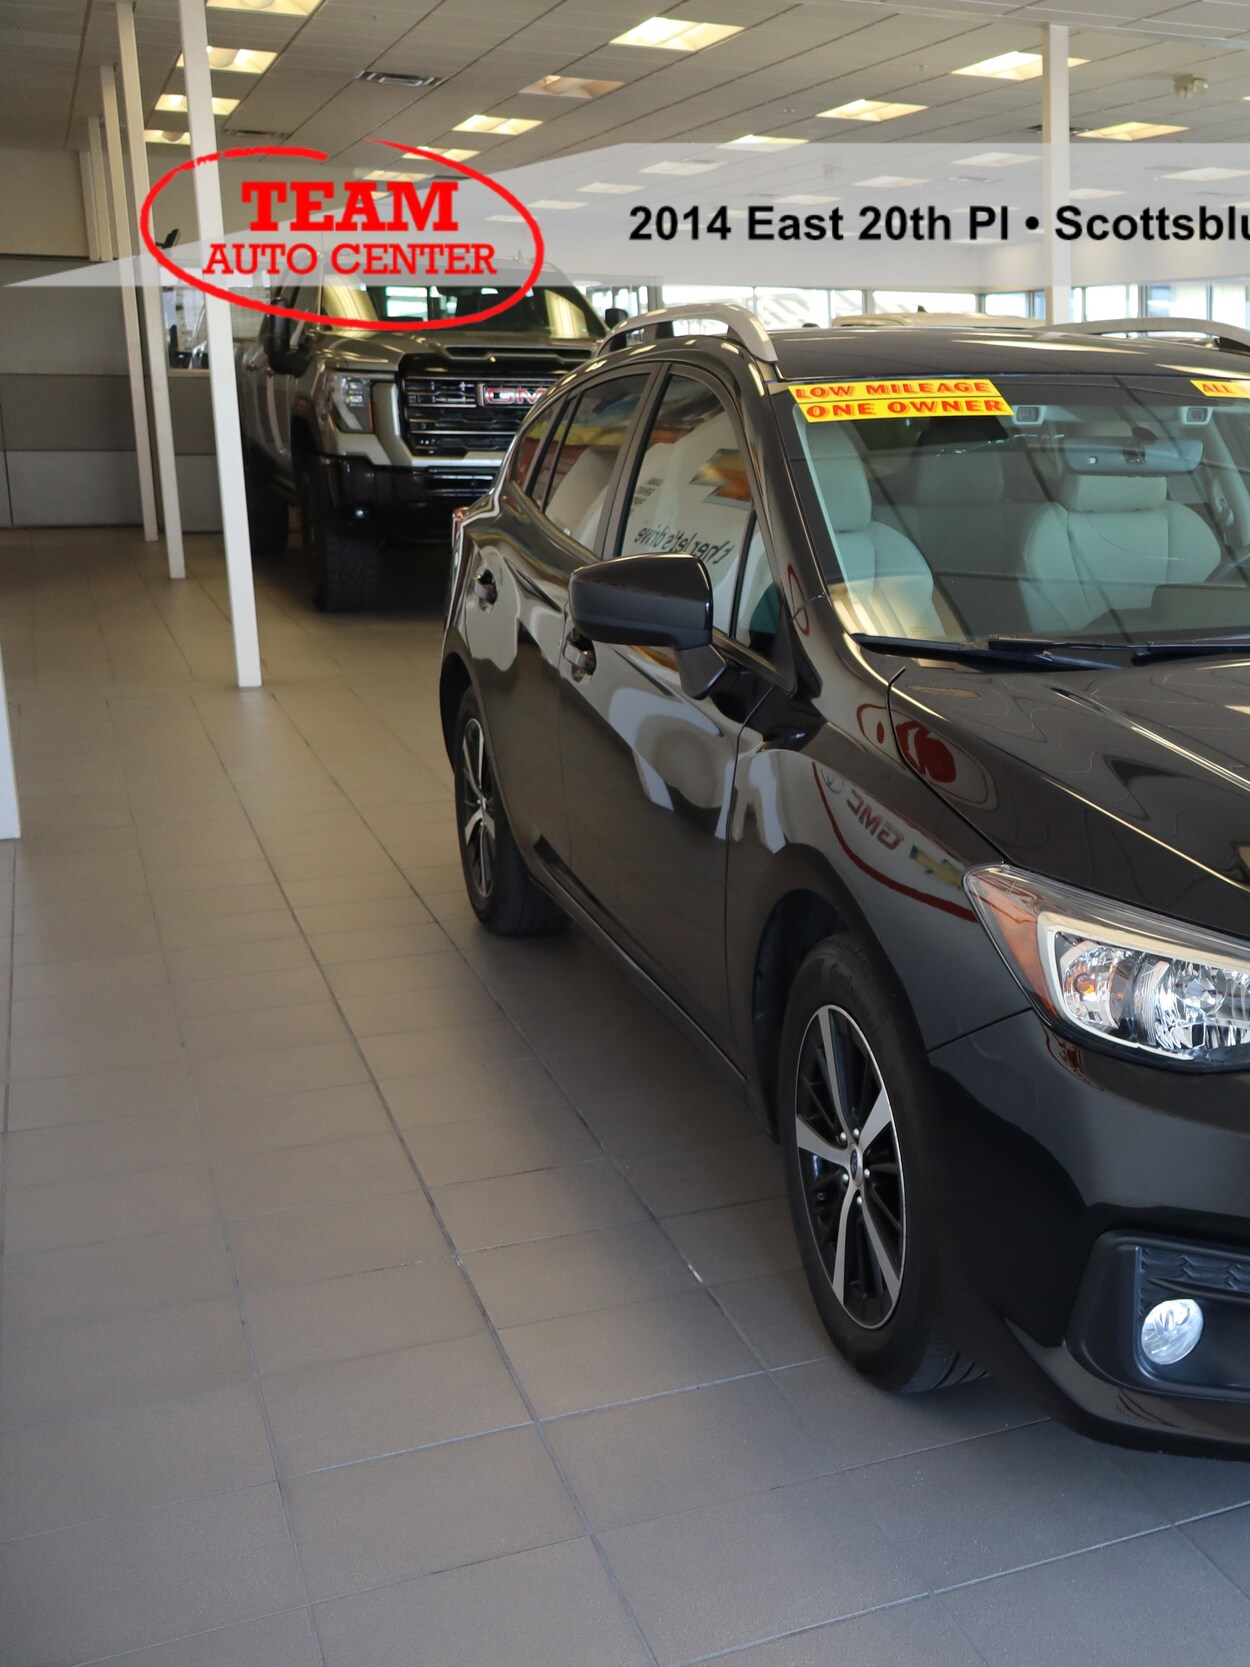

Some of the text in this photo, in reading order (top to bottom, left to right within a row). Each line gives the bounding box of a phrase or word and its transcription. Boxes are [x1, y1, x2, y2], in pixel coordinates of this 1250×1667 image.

[485, 387, 547, 404] GM
[795, 382, 990, 399] LOW MILEAGE
[1202, 383, 1232, 393] ALL
[806, 400, 1005, 417] ONE OWNER
